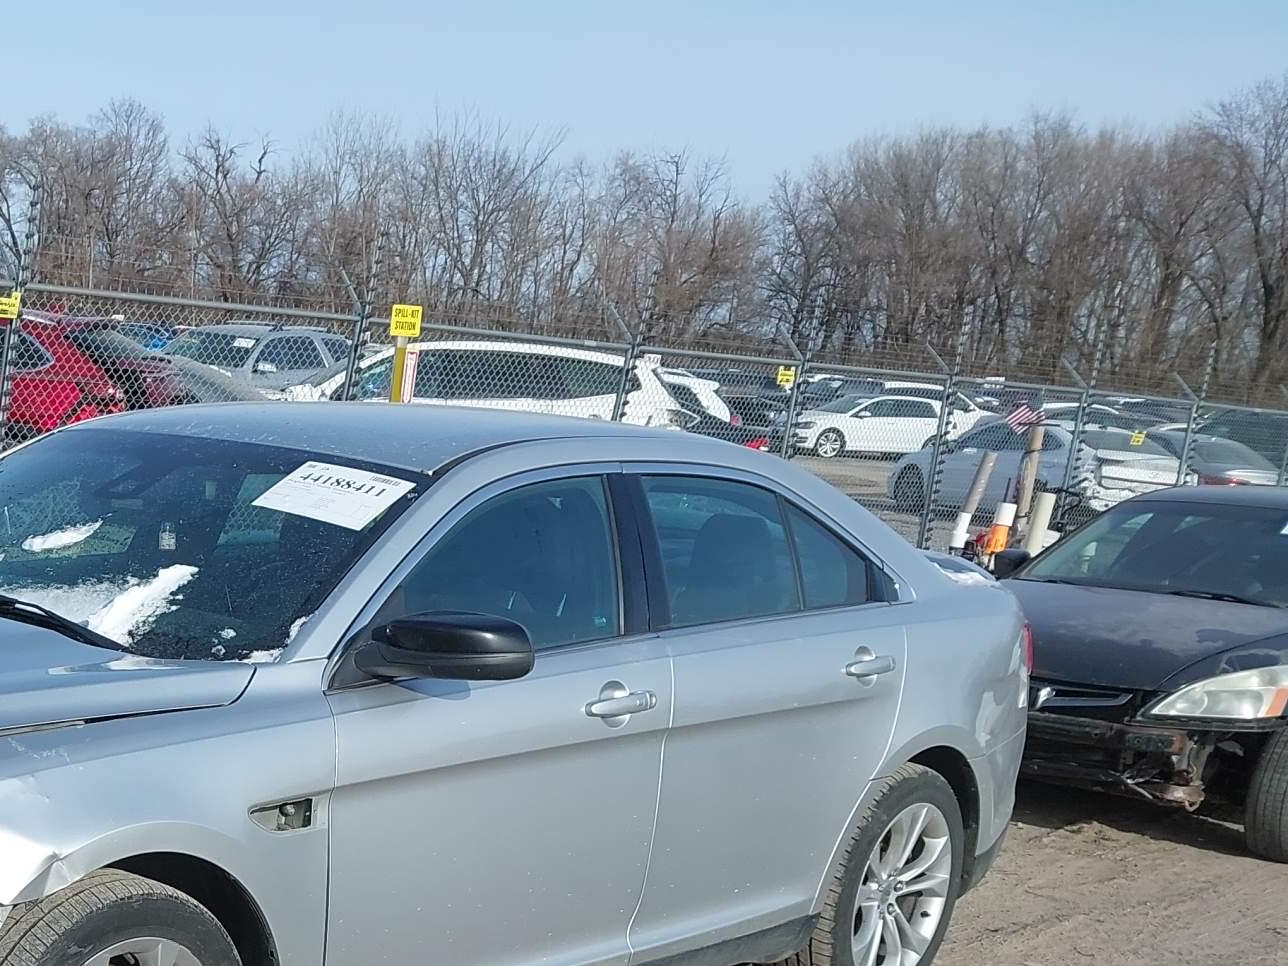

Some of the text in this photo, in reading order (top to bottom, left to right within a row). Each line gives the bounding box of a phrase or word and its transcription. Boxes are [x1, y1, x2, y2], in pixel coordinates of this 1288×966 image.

[394, 308, 420, 319] SPILL-KIT
[394, 321, 417, 331] STATION
[299, 472, 387, 497] 44188411
